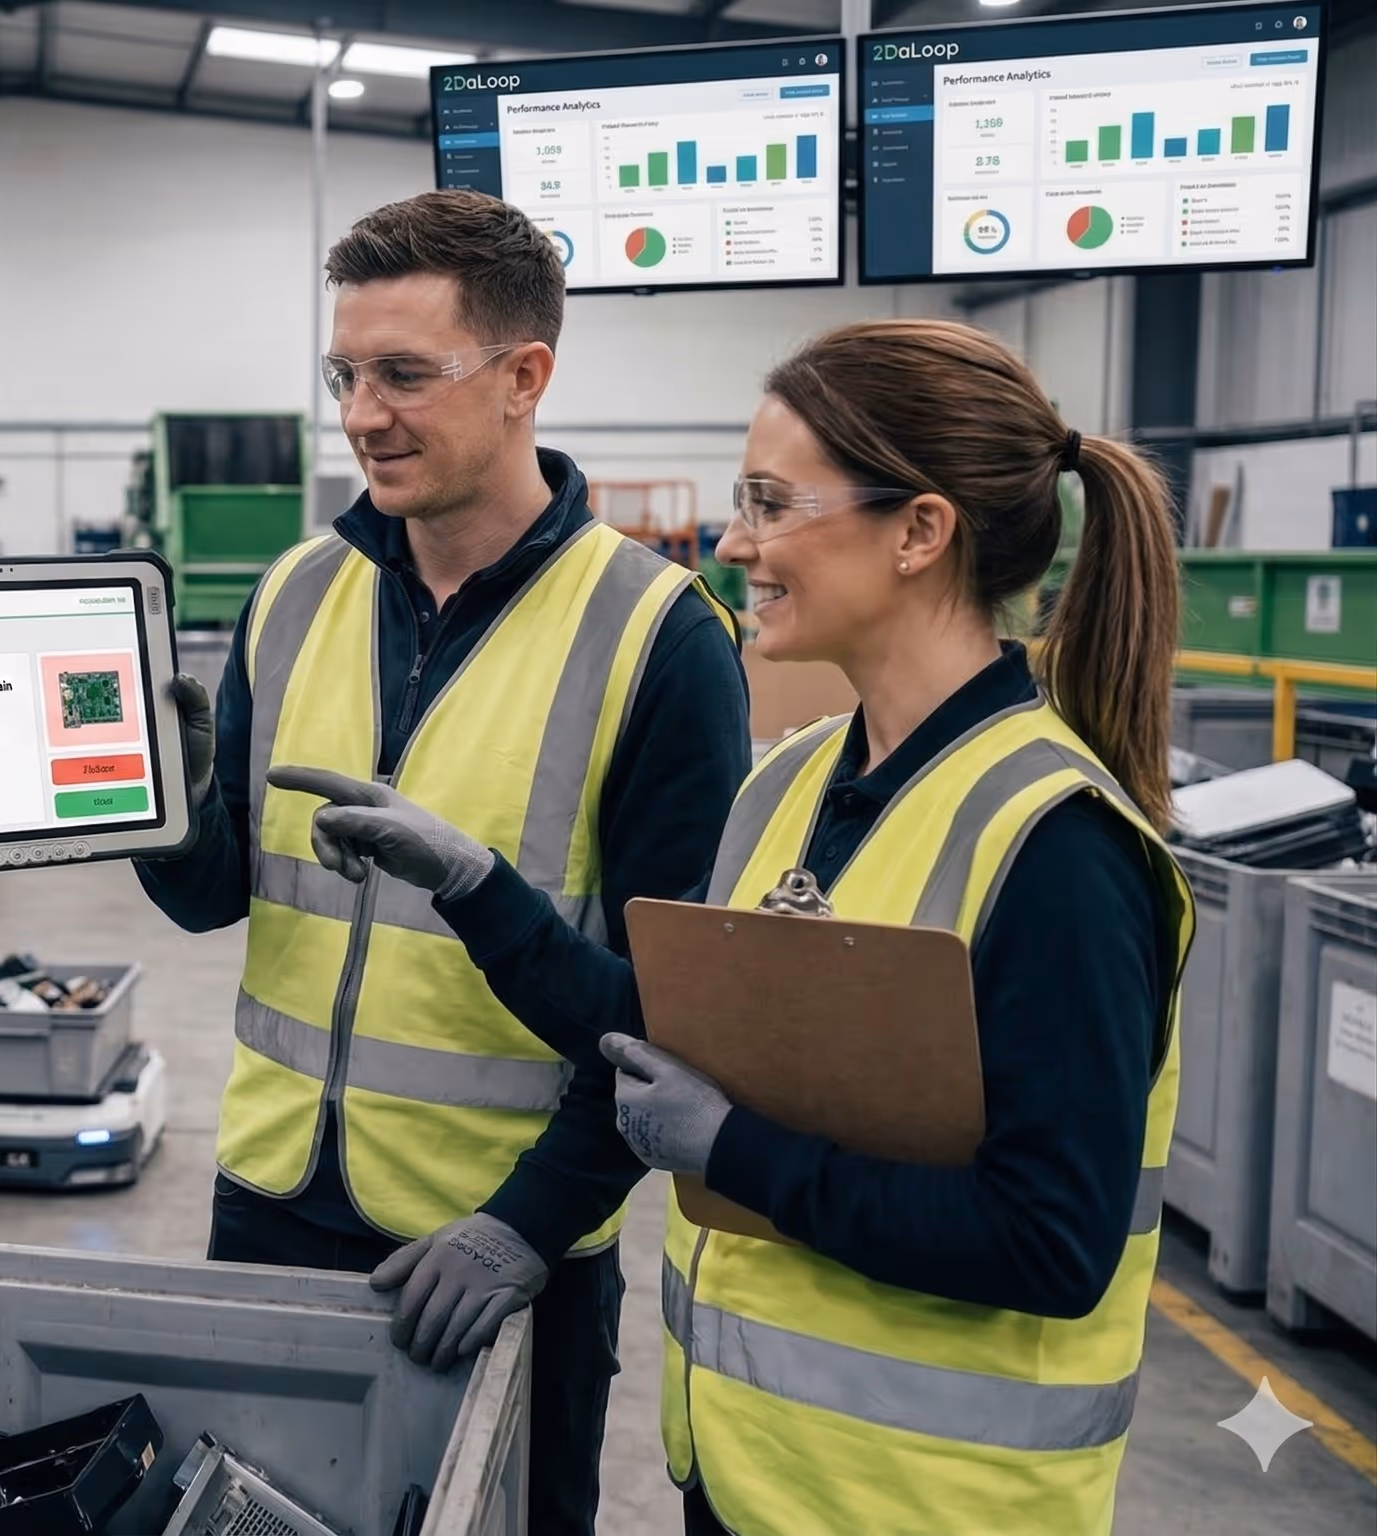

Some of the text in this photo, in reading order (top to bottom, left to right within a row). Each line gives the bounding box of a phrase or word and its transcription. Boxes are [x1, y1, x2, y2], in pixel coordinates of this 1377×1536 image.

[873, 42, 960, 61] 2DaLoop
[443, 74, 521, 91] 2DaLoop
[943, 69, 1051, 86] Performance Analytics
[506, 99, 601, 114] Performance Analytics
